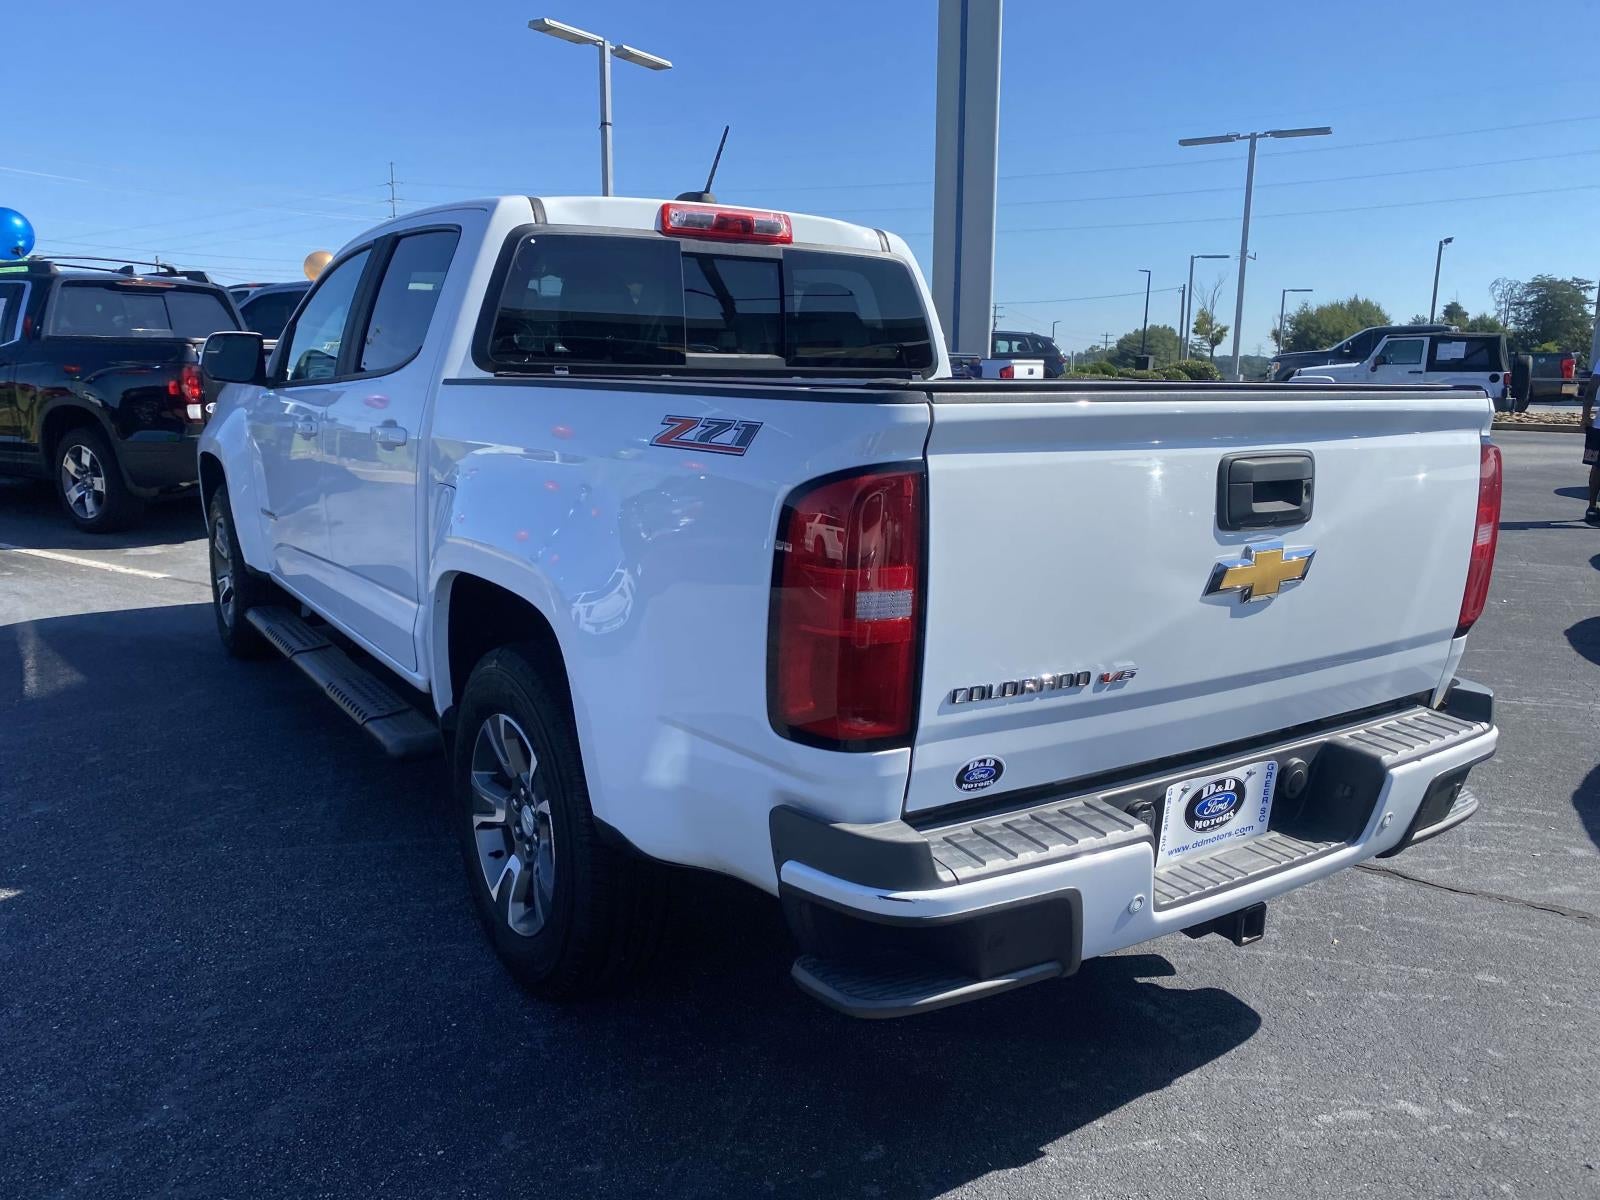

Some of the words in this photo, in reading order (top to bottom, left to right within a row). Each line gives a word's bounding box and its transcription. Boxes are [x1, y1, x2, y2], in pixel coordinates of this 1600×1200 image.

[649, 415, 764, 457] Z71
[950, 670, 1091, 704] COLORADO
[1099, 669, 1138, 684] V6
[968, 759, 996, 771] D&D
[970, 769, 990, 781] Ford
[1201, 778, 1236, 799] D&D
[1261, 763, 1274, 804] GREER
[1203, 796, 1231, 816] Ford
[1258, 807, 1266, 823] SC
[1193, 809, 1235, 830] MOTORS
[1167, 824, 1254, 856] www.ddmotors.com
